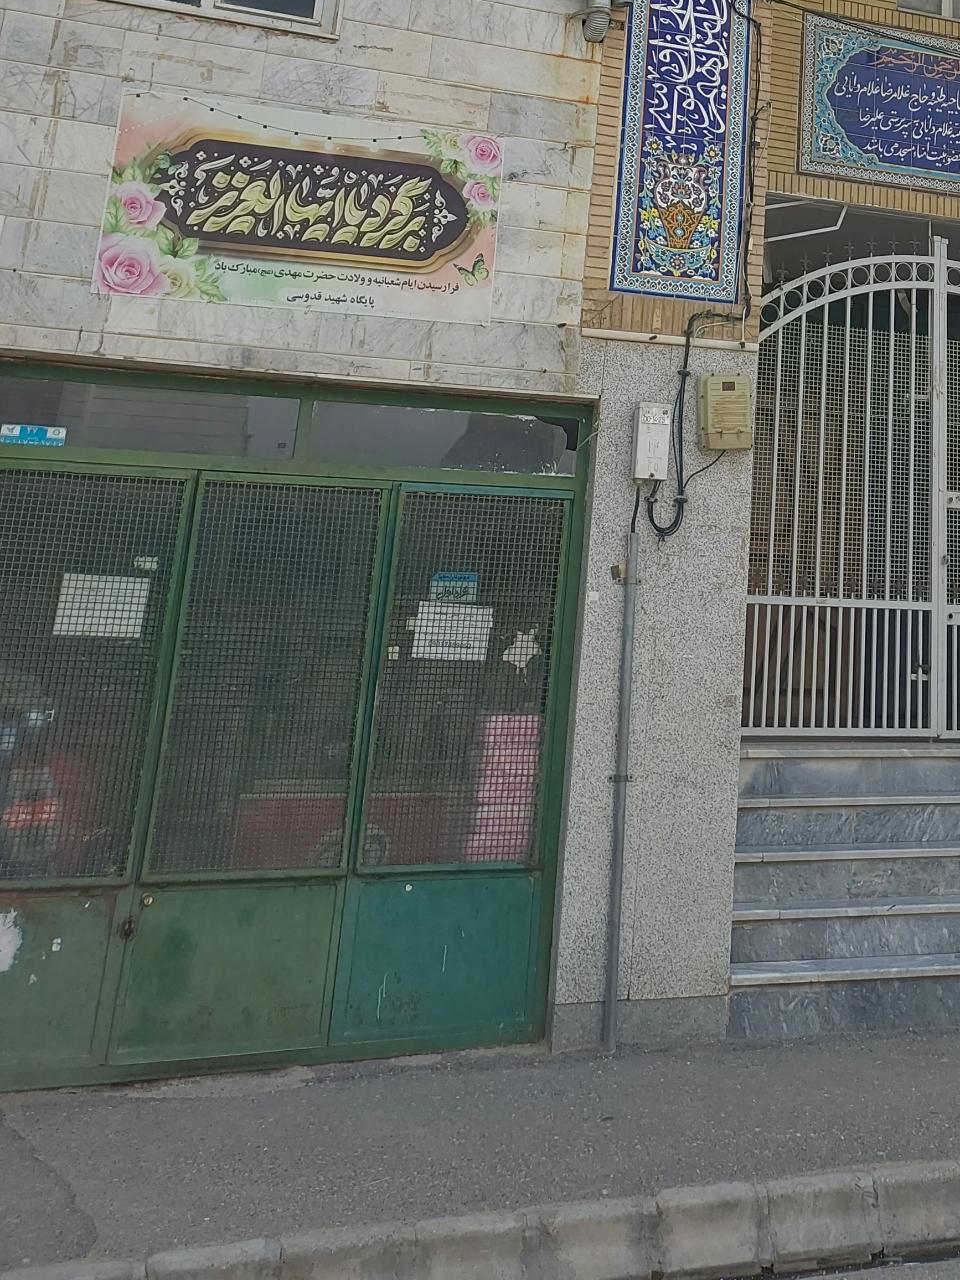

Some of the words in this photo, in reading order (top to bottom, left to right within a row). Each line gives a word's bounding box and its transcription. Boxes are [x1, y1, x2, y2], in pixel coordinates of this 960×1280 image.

[909, 84, 930, 111] حاج
[214, 261, 227, 274] باد
[227, 262, 257, 276] مبارک
[273, 268, 303, 280] مهدی
[302, 269, 337, 283] حضرت
[337, 272, 366, 286] ولادت
[365, 278, 373, 287] و
[373, 276, 401, 288] شعبانیه
[400, 279, 417, 290] ایام
[286, 291, 323, 303] قدوسی
[324, 293, 348, 305] شهید
[349, 294, 375, 309] پایگاه
